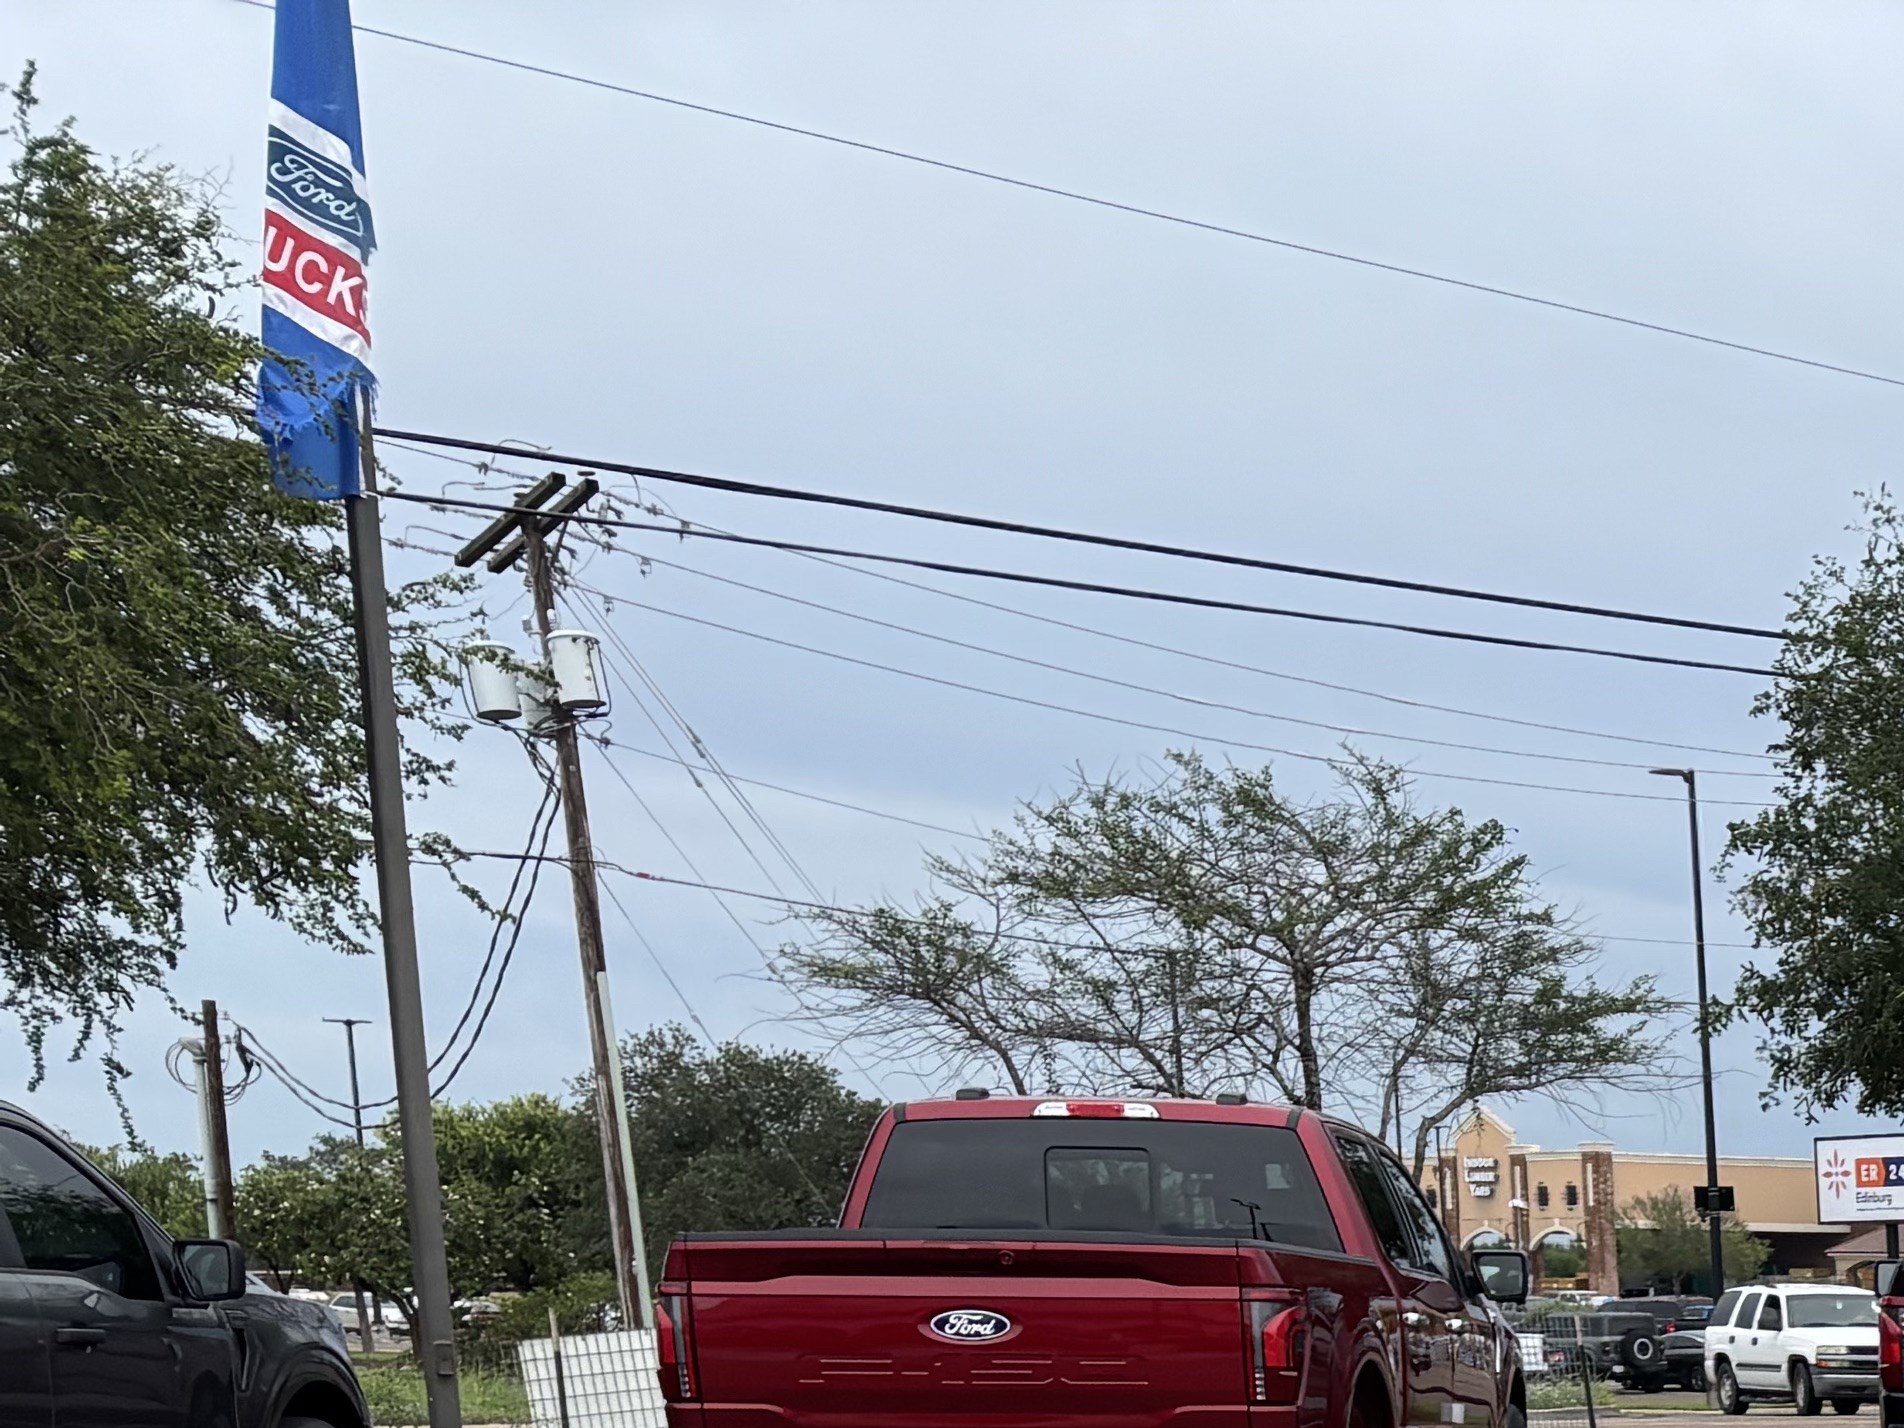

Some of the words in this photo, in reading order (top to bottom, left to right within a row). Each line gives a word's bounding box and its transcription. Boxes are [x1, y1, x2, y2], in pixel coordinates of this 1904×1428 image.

[270, 153, 358, 222] Ford
[264, 225, 367, 321] UCK
[1860, 1163, 1879, 1182] ER
[944, 1313, 996, 1336] Ford
